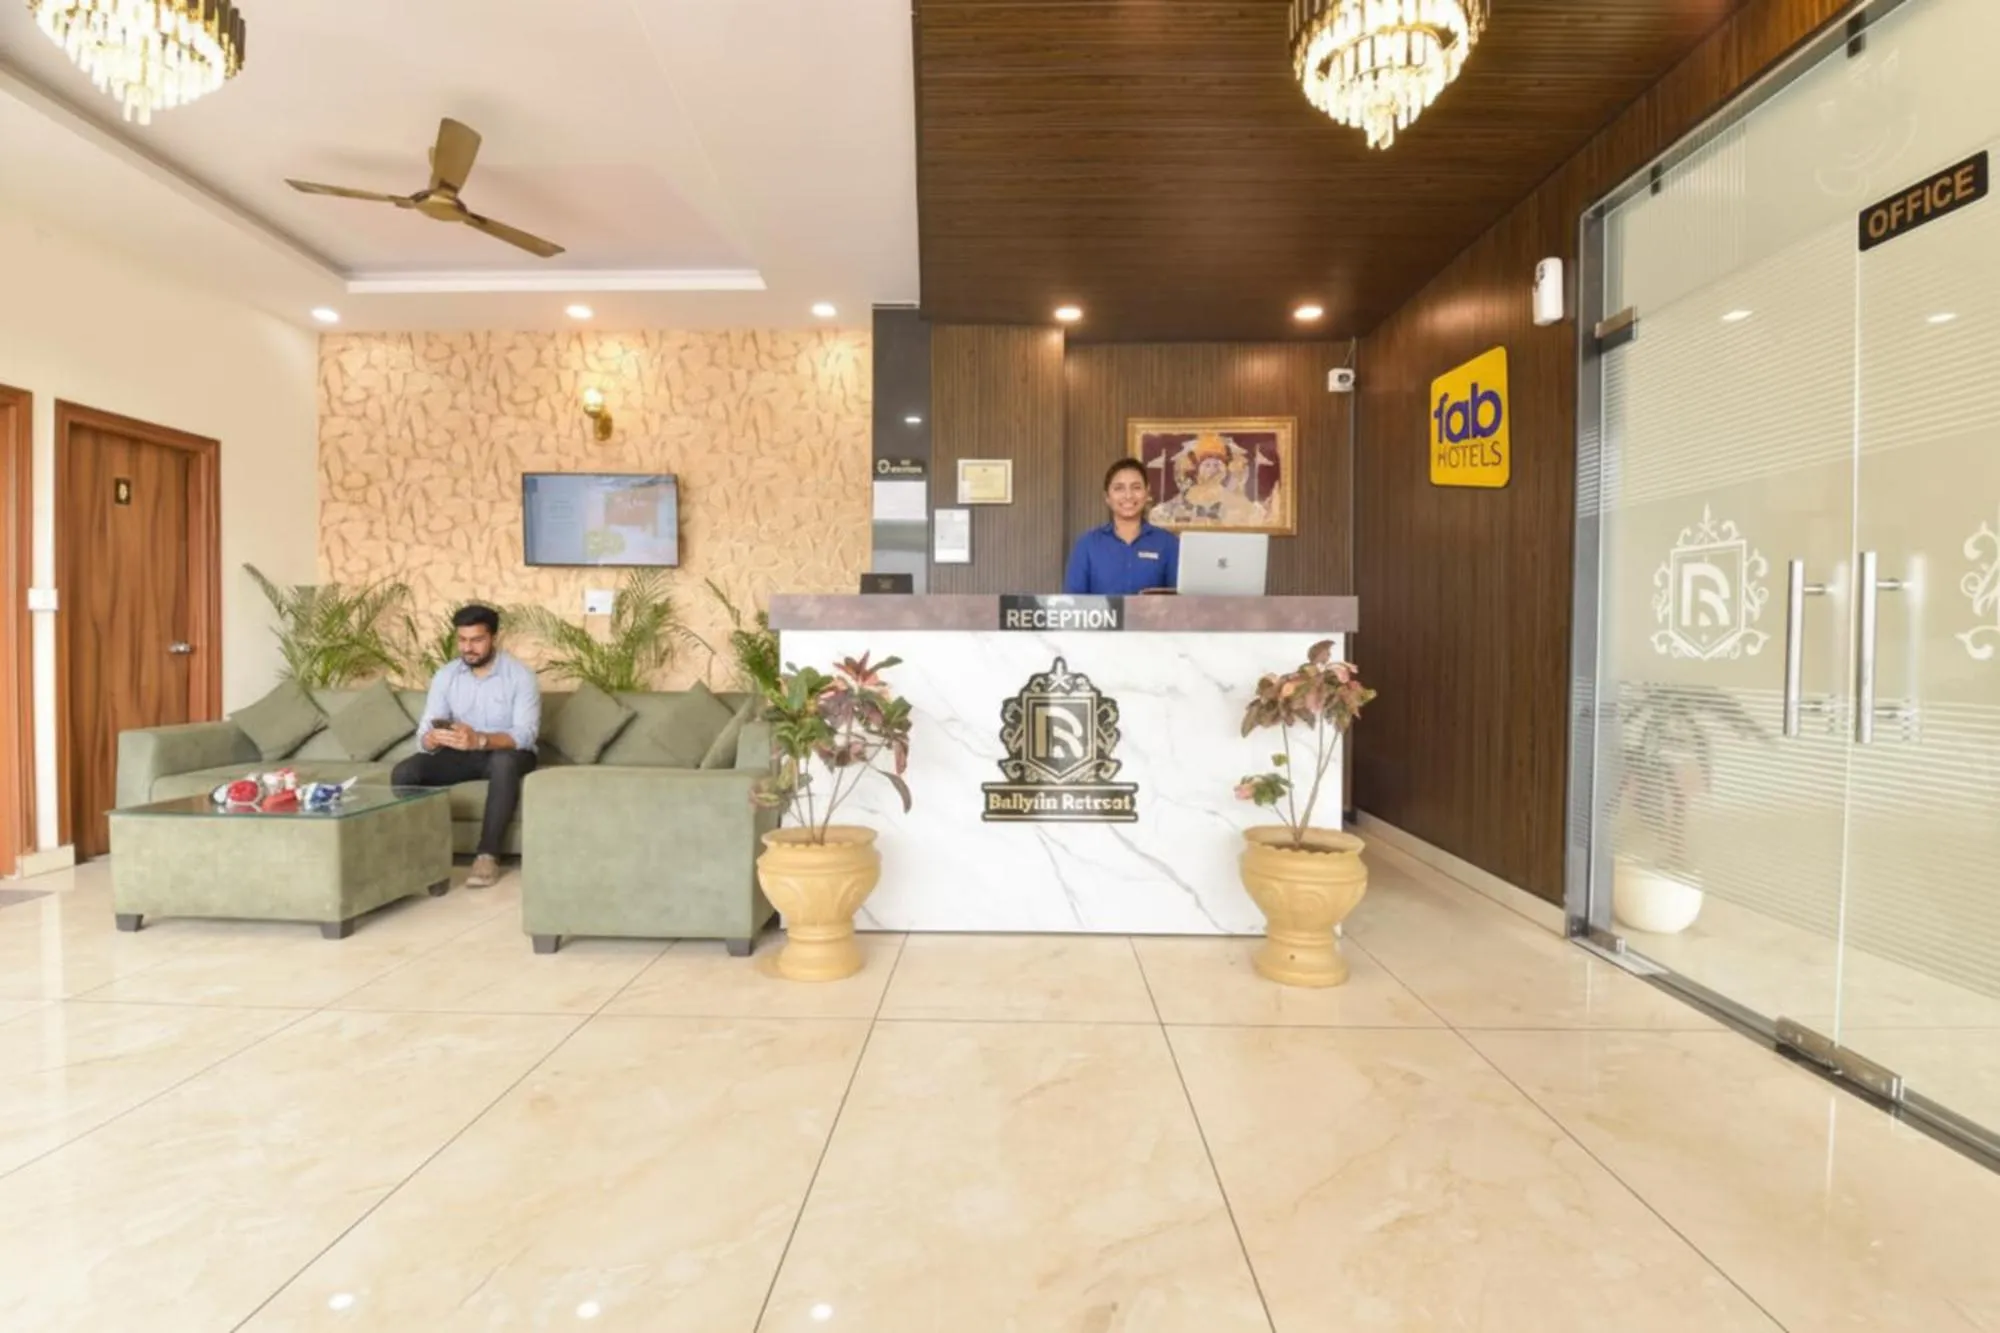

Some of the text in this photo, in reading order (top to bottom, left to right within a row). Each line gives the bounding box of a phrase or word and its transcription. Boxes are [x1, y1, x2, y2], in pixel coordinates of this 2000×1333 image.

[1868, 164, 1975, 239] OFFICE
[1433, 382, 1503, 444] fab
[1437, 441, 1503, 468] HOTELS
[1006, 609, 1117, 628] RECEPTION
[989, 791, 1131, 813] Ballyfin Retreat
